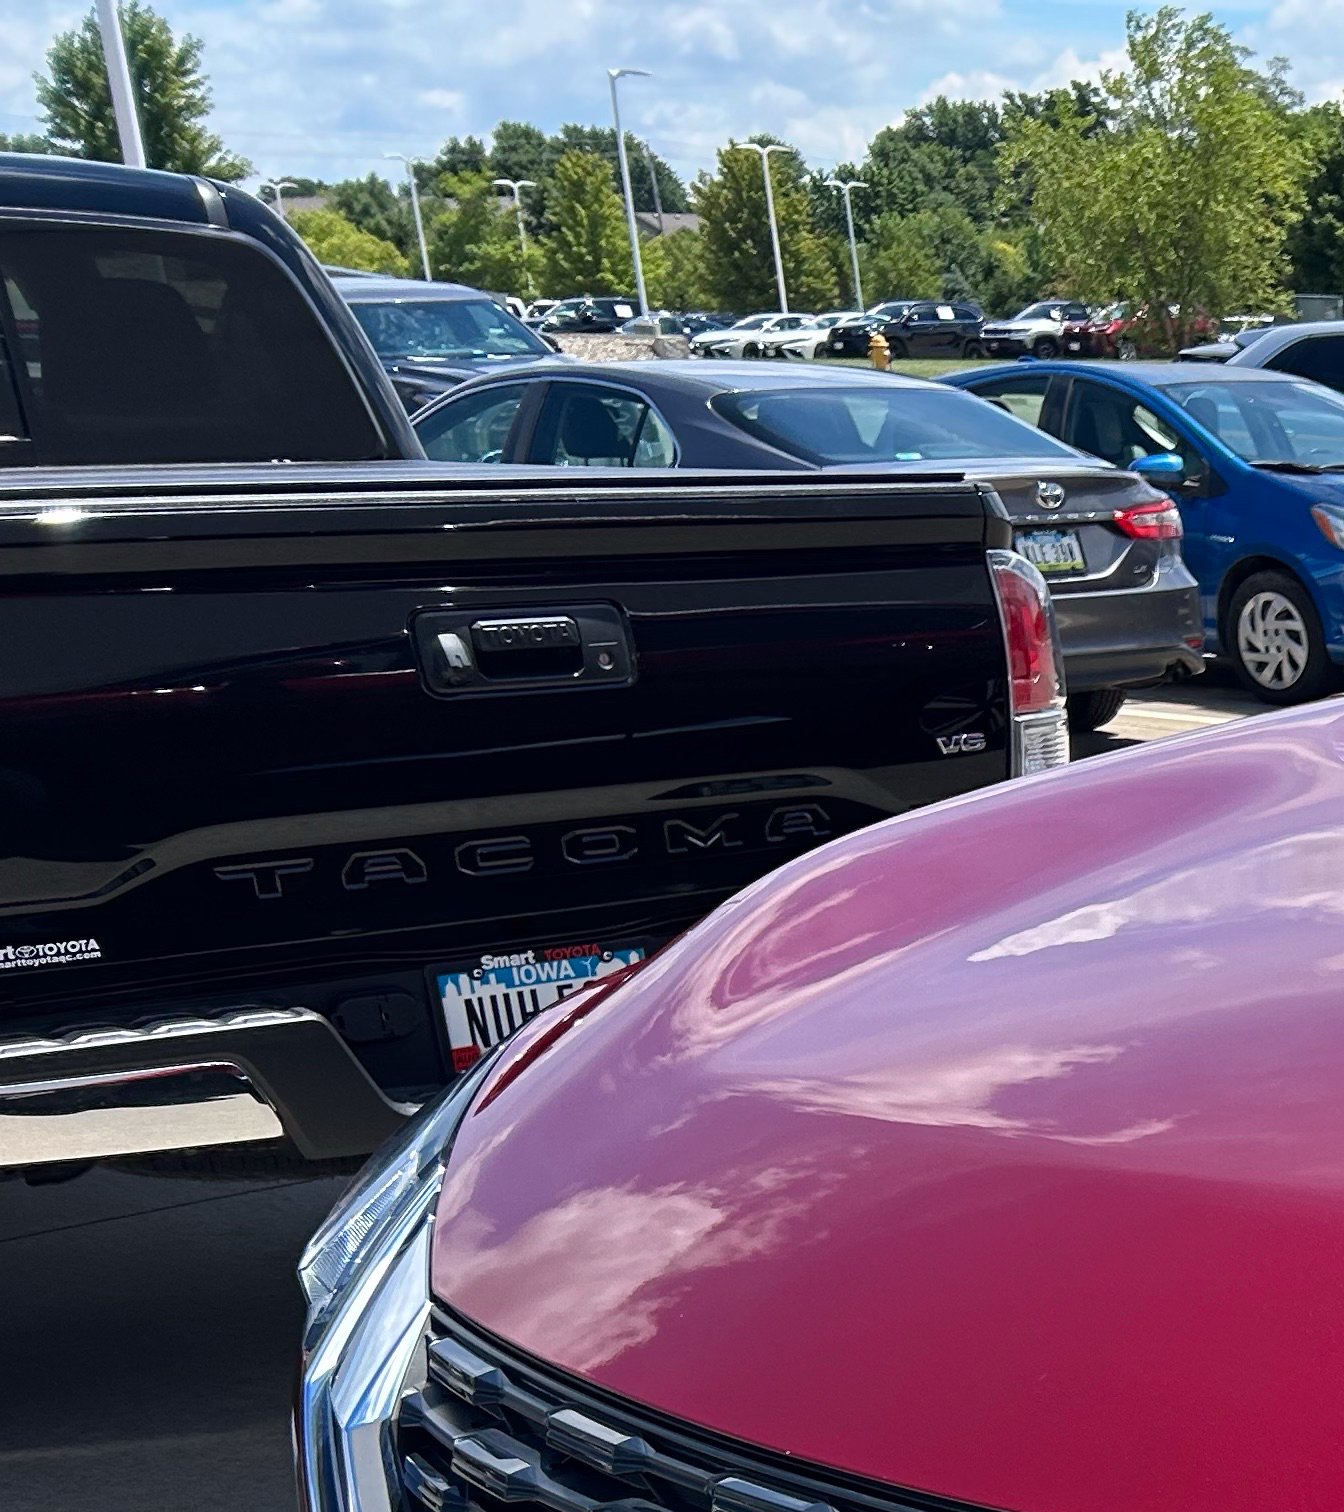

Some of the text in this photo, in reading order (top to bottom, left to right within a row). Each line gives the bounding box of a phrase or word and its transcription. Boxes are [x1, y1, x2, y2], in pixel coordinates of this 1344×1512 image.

[482, 622, 574, 645] TOYOTA
[935, 732, 987, 755] V6
[213, 803, 832, 900] TACOMA
[36, 938, 100, 956] TOYOTA
[480, 944, 601, 970] Smart TOYOTA
[512, 961, 576, 986] IOWA
